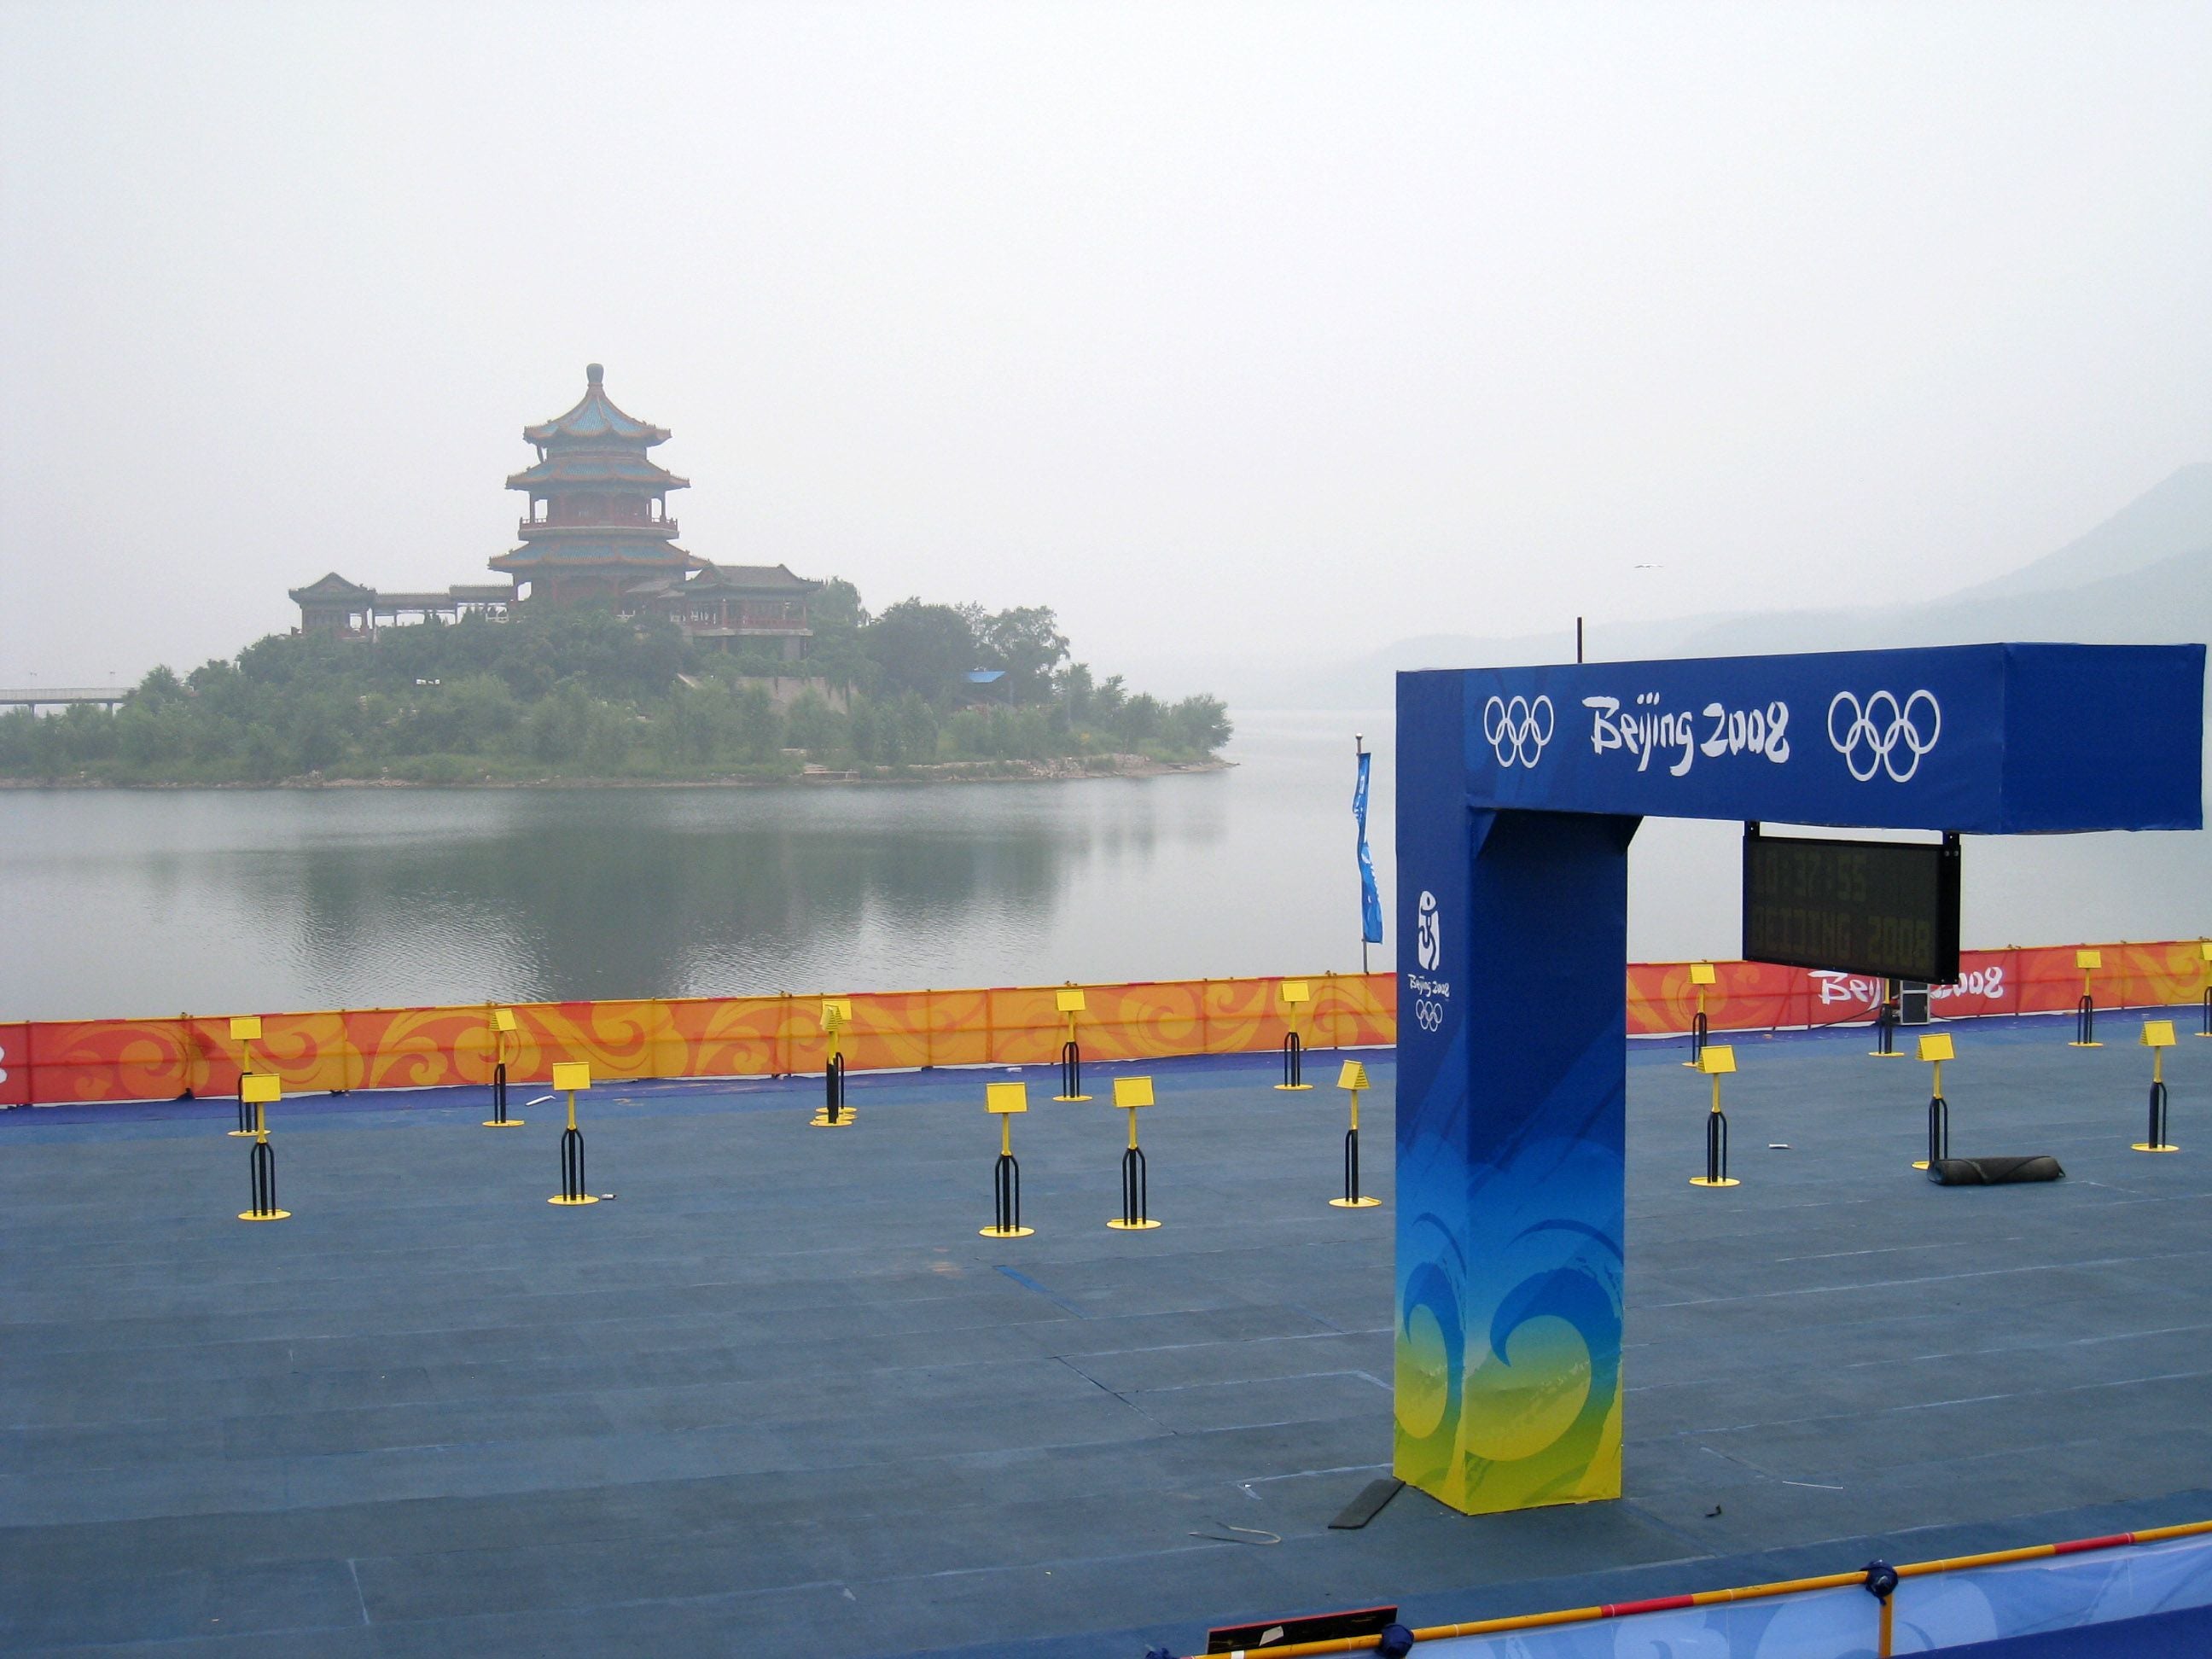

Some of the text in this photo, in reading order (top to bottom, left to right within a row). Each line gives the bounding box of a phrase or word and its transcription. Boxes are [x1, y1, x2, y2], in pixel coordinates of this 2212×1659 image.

[1581, 691, 1790, 777] Beijing 2008
[1752, 904, 1932, 970] BEIJING 2008
[1407, 973, 1450, 998] Beijing 2008
